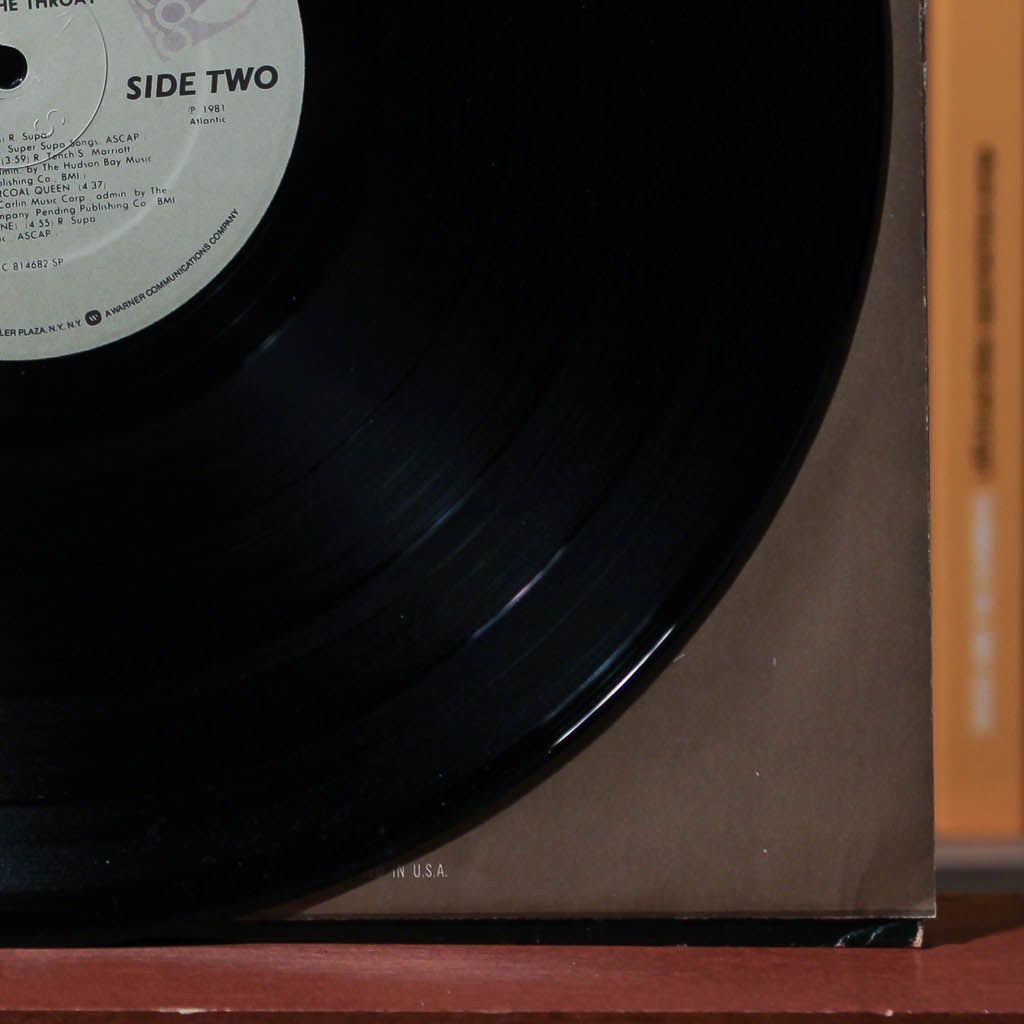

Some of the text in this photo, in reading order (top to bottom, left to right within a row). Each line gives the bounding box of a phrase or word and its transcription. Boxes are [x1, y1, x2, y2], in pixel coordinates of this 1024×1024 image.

[126, 65, 279, 100] SIDE TWO
[203, 104, 226, 114] 1981
[189, 117, 227, 126] Atlantic
[105, 208, 240, 318] A WARNER COMMUNICATIONS COMPANY
[413, 863, 448, 878] U.S.A.
